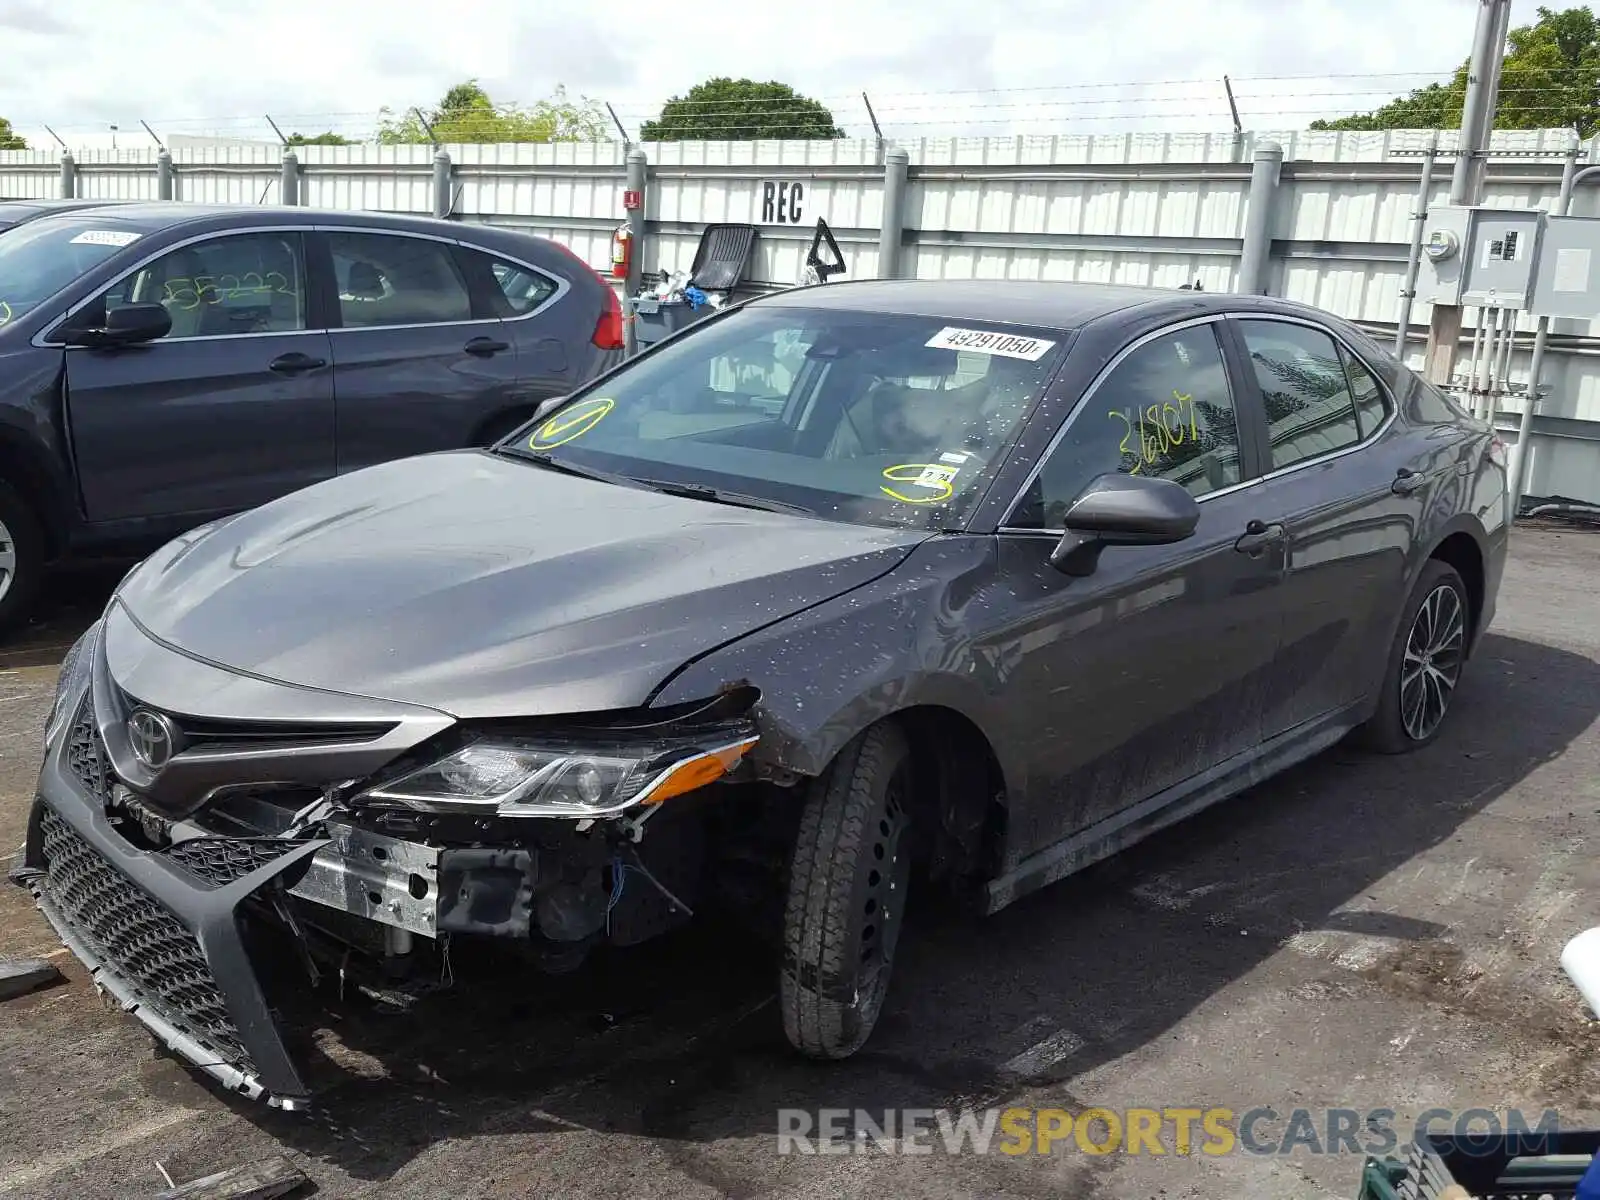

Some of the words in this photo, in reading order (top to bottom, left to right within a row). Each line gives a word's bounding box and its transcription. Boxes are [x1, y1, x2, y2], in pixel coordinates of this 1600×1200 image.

[762, 182, 803, 224] REC
[163, 272, 296, 310] 55222
[1108, 390, 1197, 476] 36807
